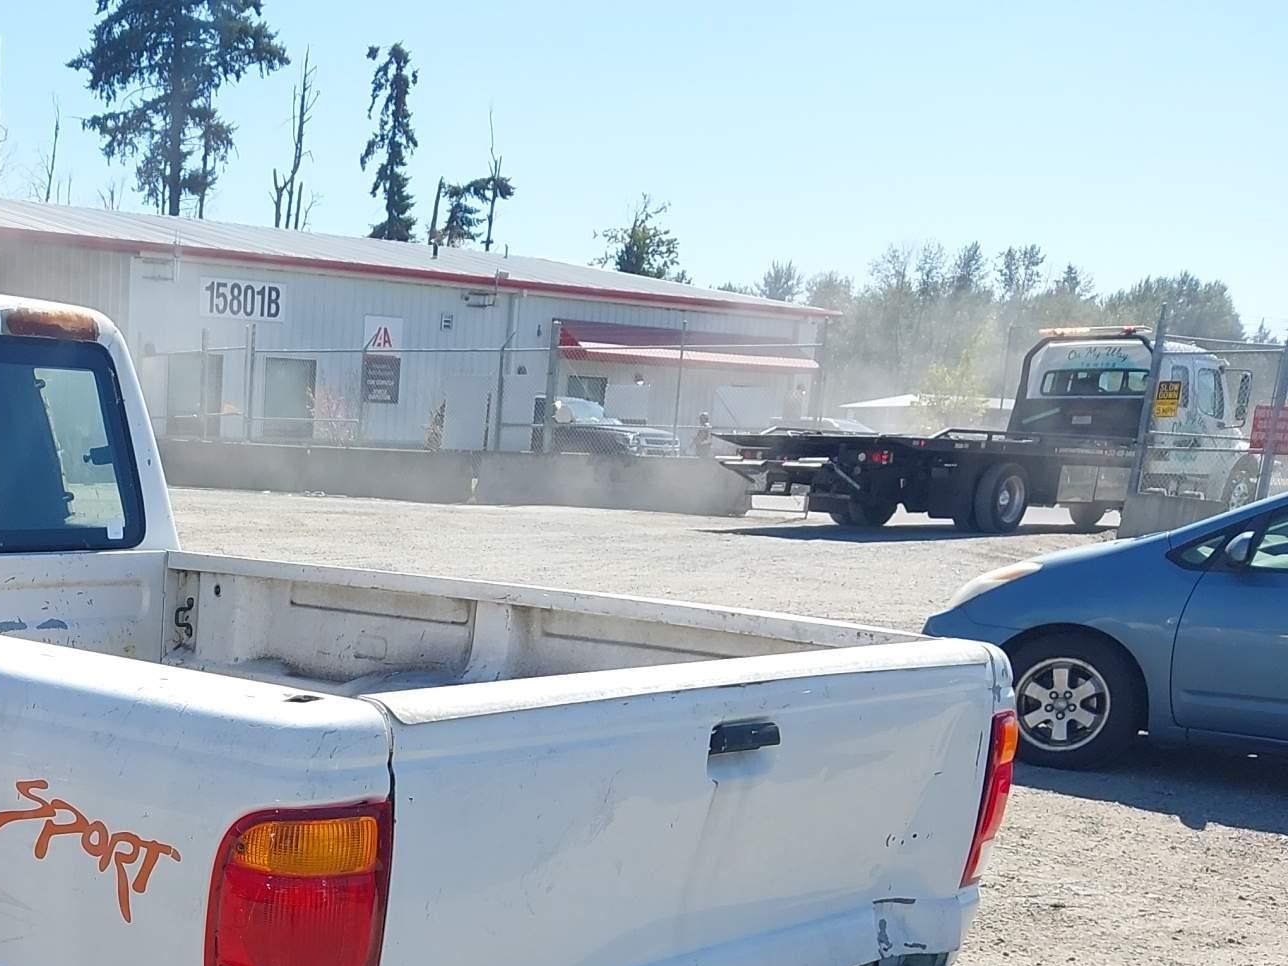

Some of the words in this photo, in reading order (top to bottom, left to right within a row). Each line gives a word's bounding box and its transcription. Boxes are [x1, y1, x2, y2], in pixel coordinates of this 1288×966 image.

[205, 280, 281, 318] 15801B
[1160, 383, 1180, 392] SLOW
[1158, 391, 1178, 399] DOWN
